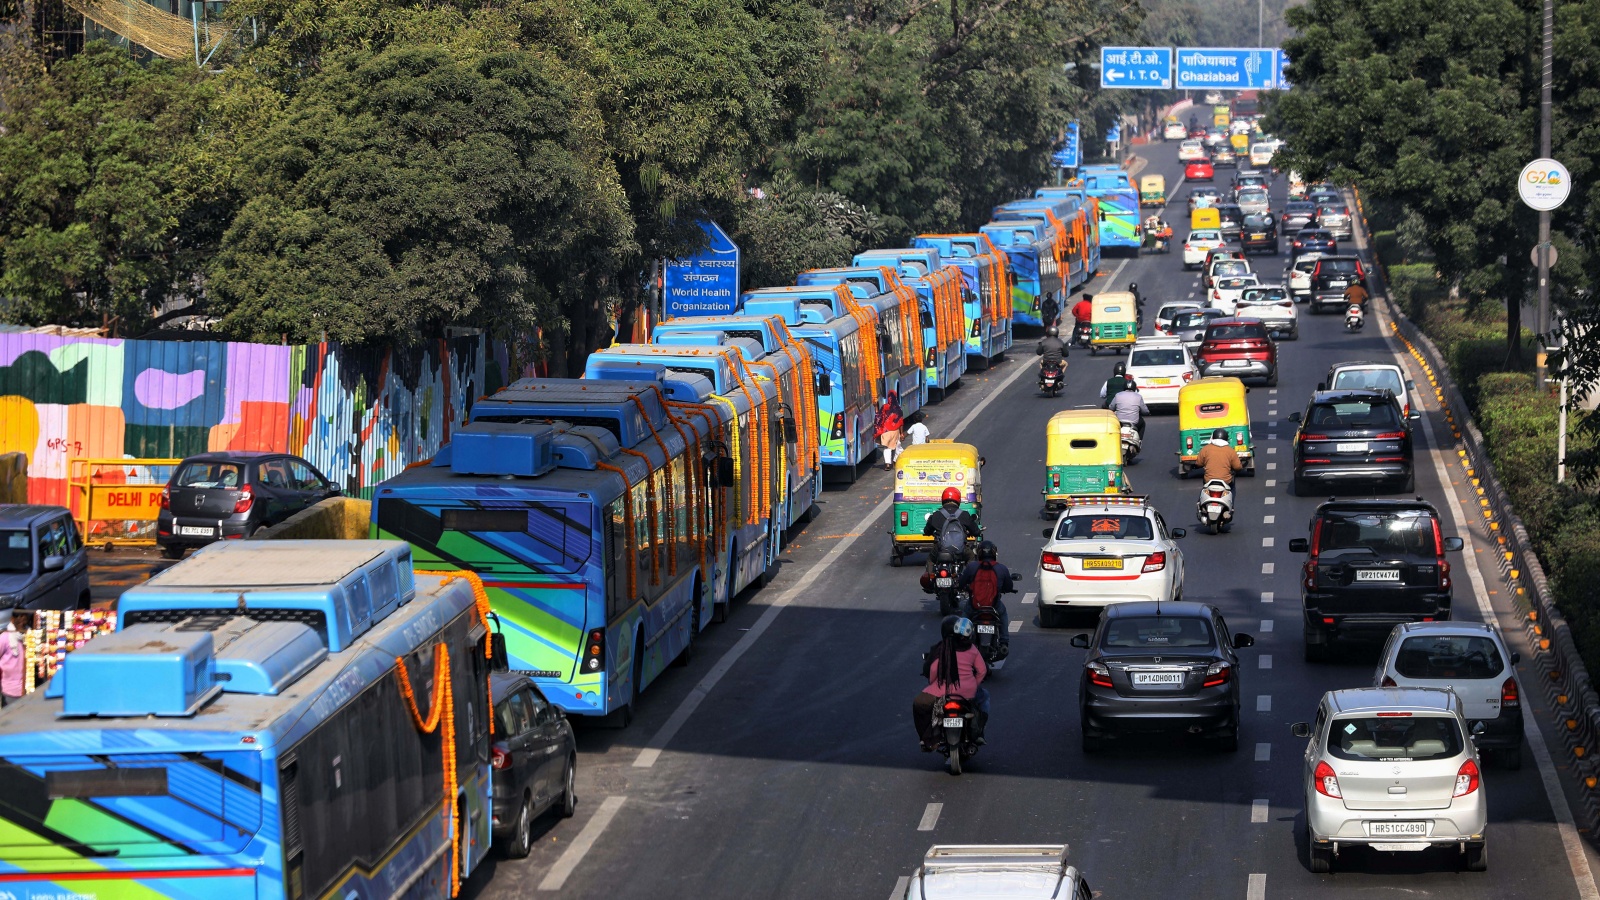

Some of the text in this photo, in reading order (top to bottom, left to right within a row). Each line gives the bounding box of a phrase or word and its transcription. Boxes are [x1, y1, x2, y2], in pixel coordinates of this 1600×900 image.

[1182, 53, 1237, 67] गाजियाबाद
[1181, 71, 1239, 82] Ghaziabad
[683, 272, 719, 282] संगठन
[672, 288, 730, 296] World Health
[671, 302, 730, 311] Organization
[108, 492, 142, 507] DELHI
[1139, 674, 1180, 682] UP14DH0011
[1375, 824, 1424, 833] HR51CC4890
